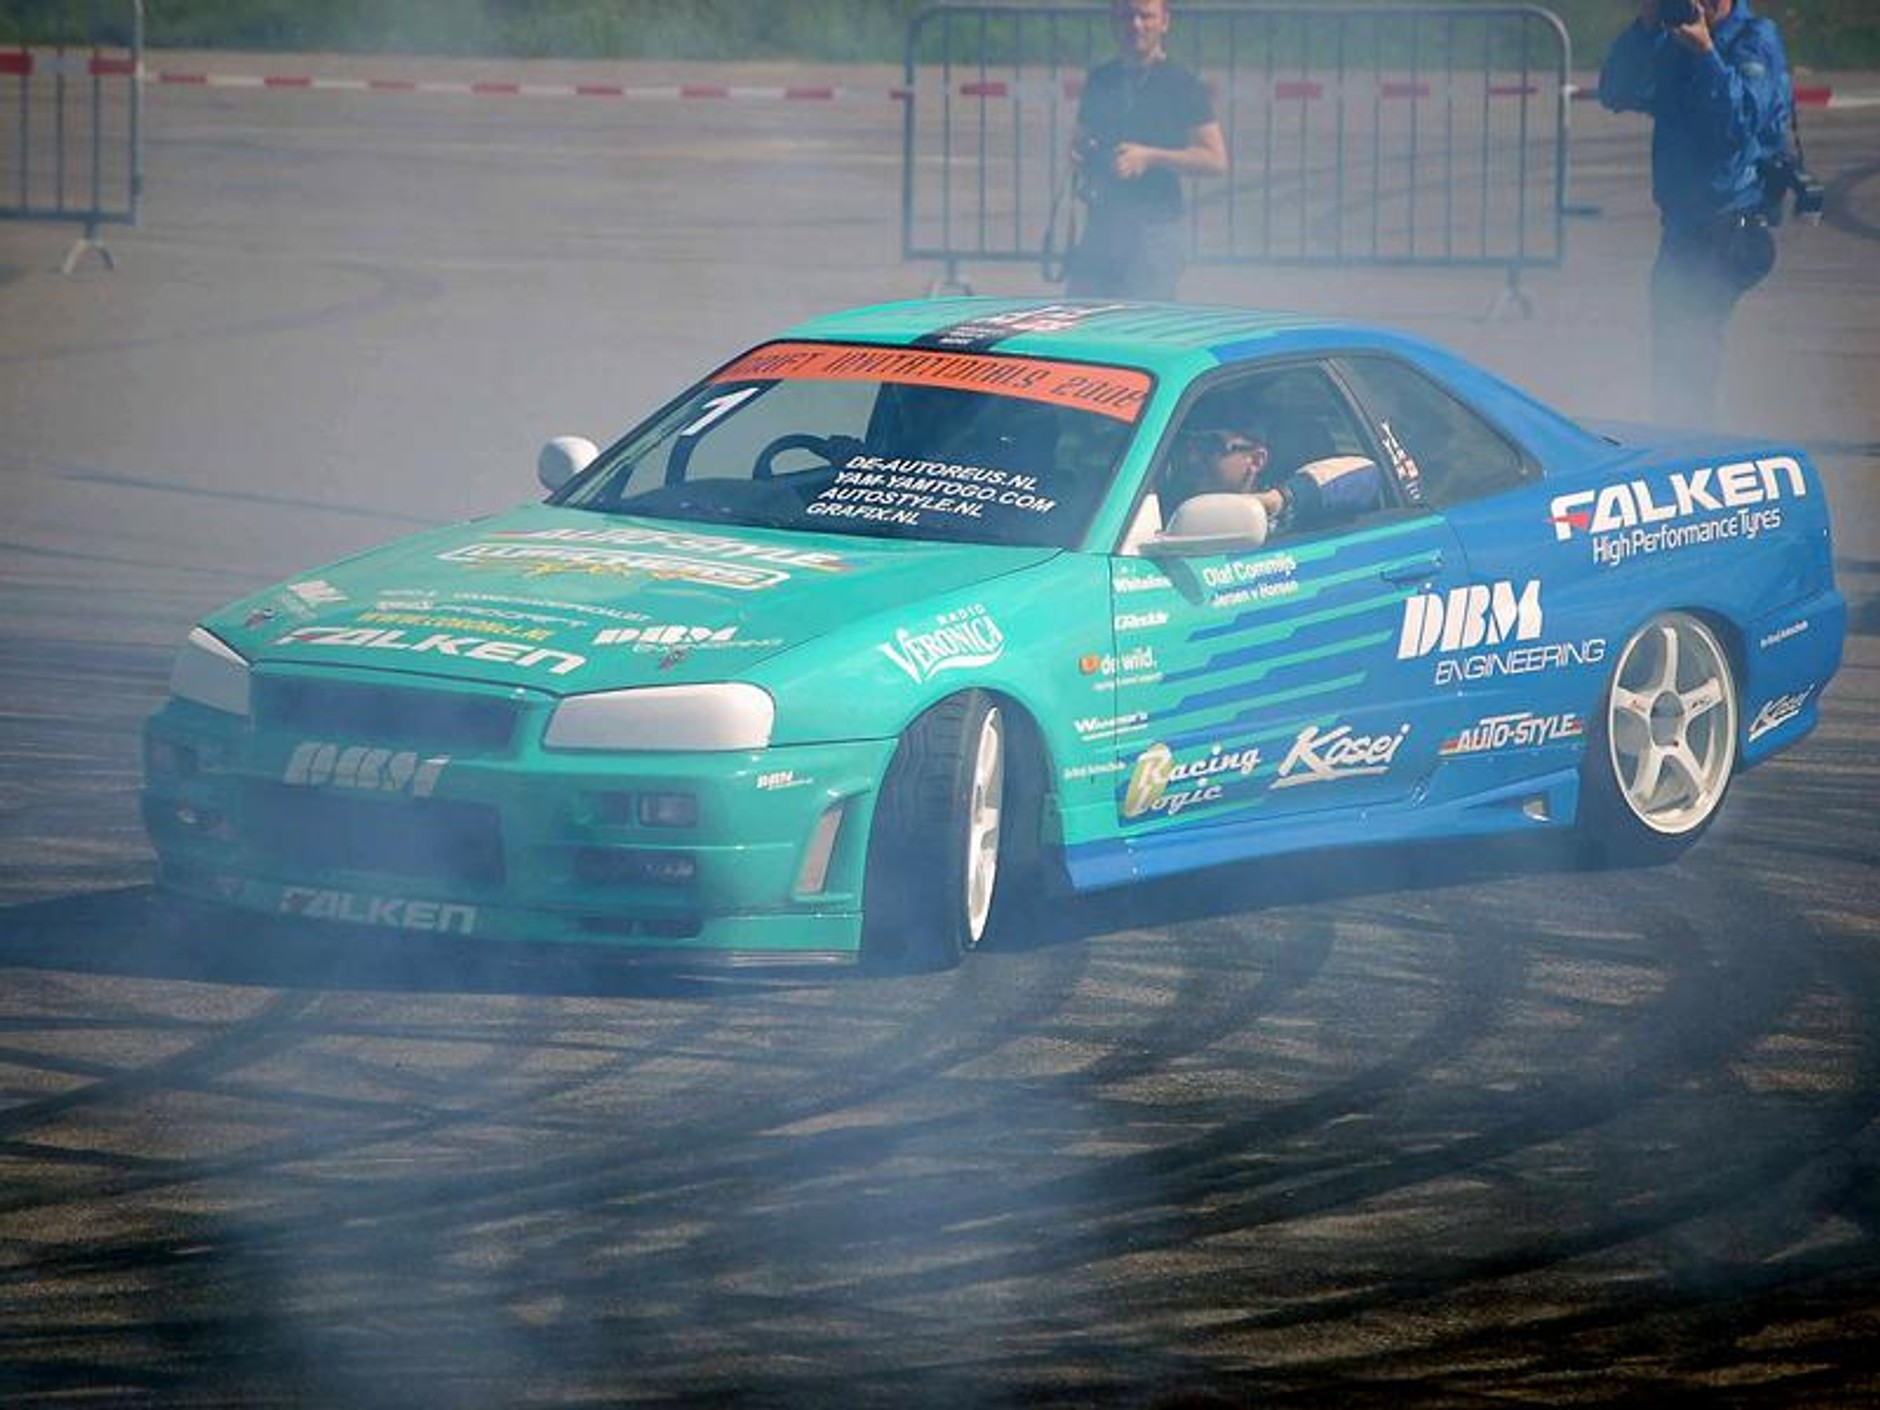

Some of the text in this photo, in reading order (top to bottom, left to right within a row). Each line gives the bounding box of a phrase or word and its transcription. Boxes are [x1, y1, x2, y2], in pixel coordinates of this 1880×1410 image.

[680, 386, 760, 438] 1
[834, 471, 1057, 514] YAM-YAMTOGO.COM
[846, 455, 1039, 491] DE-AUTOREUS.NL
[806, 502, 919, 525] GRAFIX.NL
[818, 487, 986, 518] AUTOSTYLE.NL
[1550, 456, 1807, 542] FALKEN
[1593, 507, 1782, 567] High Performance Tyres
[935, 602, 987, 625] RADIO
[1397, 580, 1543, 661] DBM
[274, 626, 587, 676] FALKEN
[878, 613, 1005, 685] VERONICA
[1434, 639, 1606, 686] ENGINEERING
[1270, 724, 1412, 786] Kosei
[1446, 713, 1581, 754] AUTO-STYLE
[279, 885, 478, 935] FALKEN
